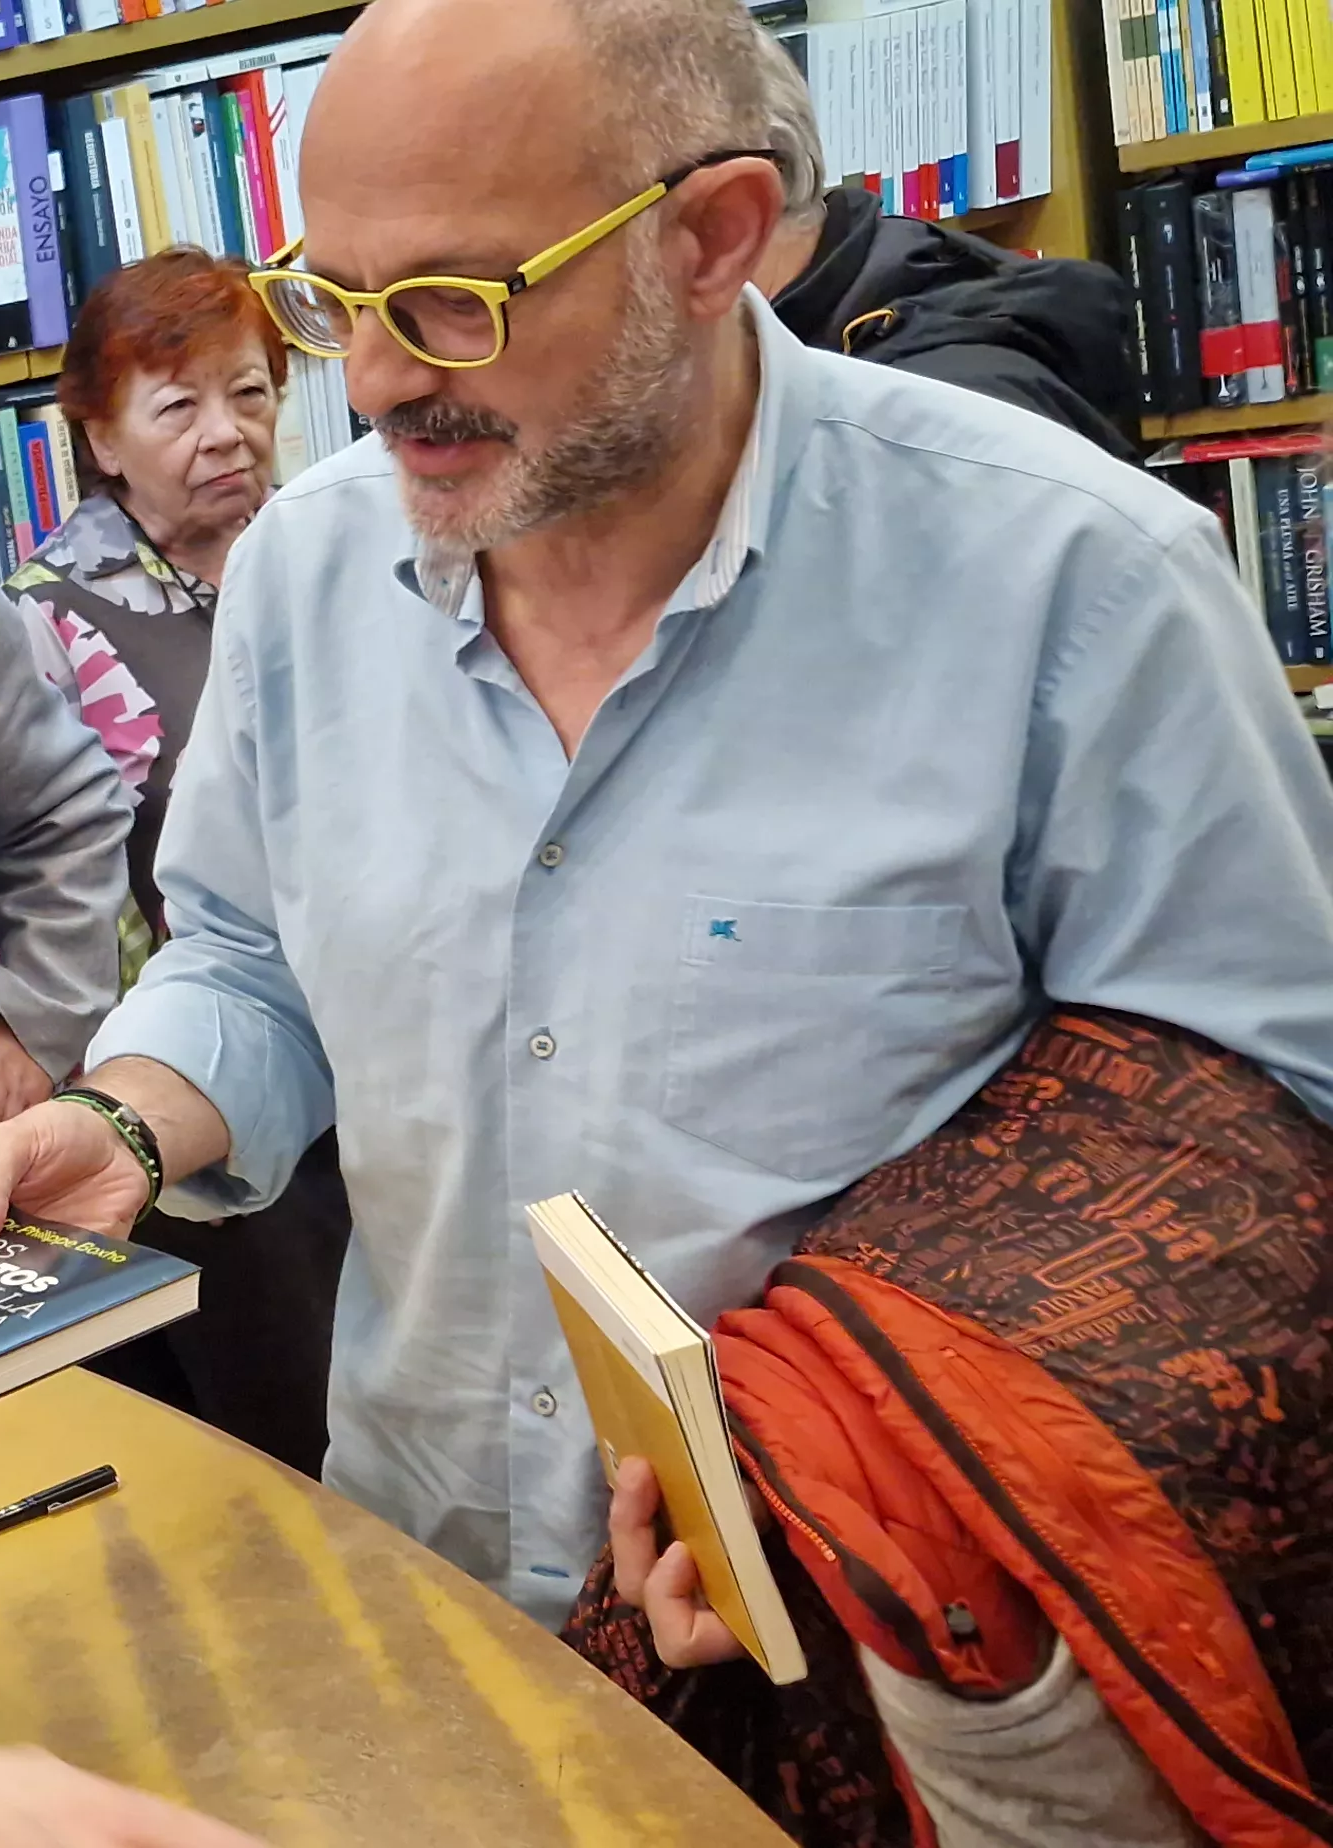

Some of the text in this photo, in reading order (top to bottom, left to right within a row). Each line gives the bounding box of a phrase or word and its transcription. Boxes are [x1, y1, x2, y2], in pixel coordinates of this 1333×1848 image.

[28, 176, 56, 263] ENSAYO
[1278, 489, 1298, 612] UNA PLUMA AIRE
[1297, 467, 1328, 637] JOHN GRISHAM
[17, 1224, 80, 1251] Philippe
[75, 1240, 128, 1265] Boxho
